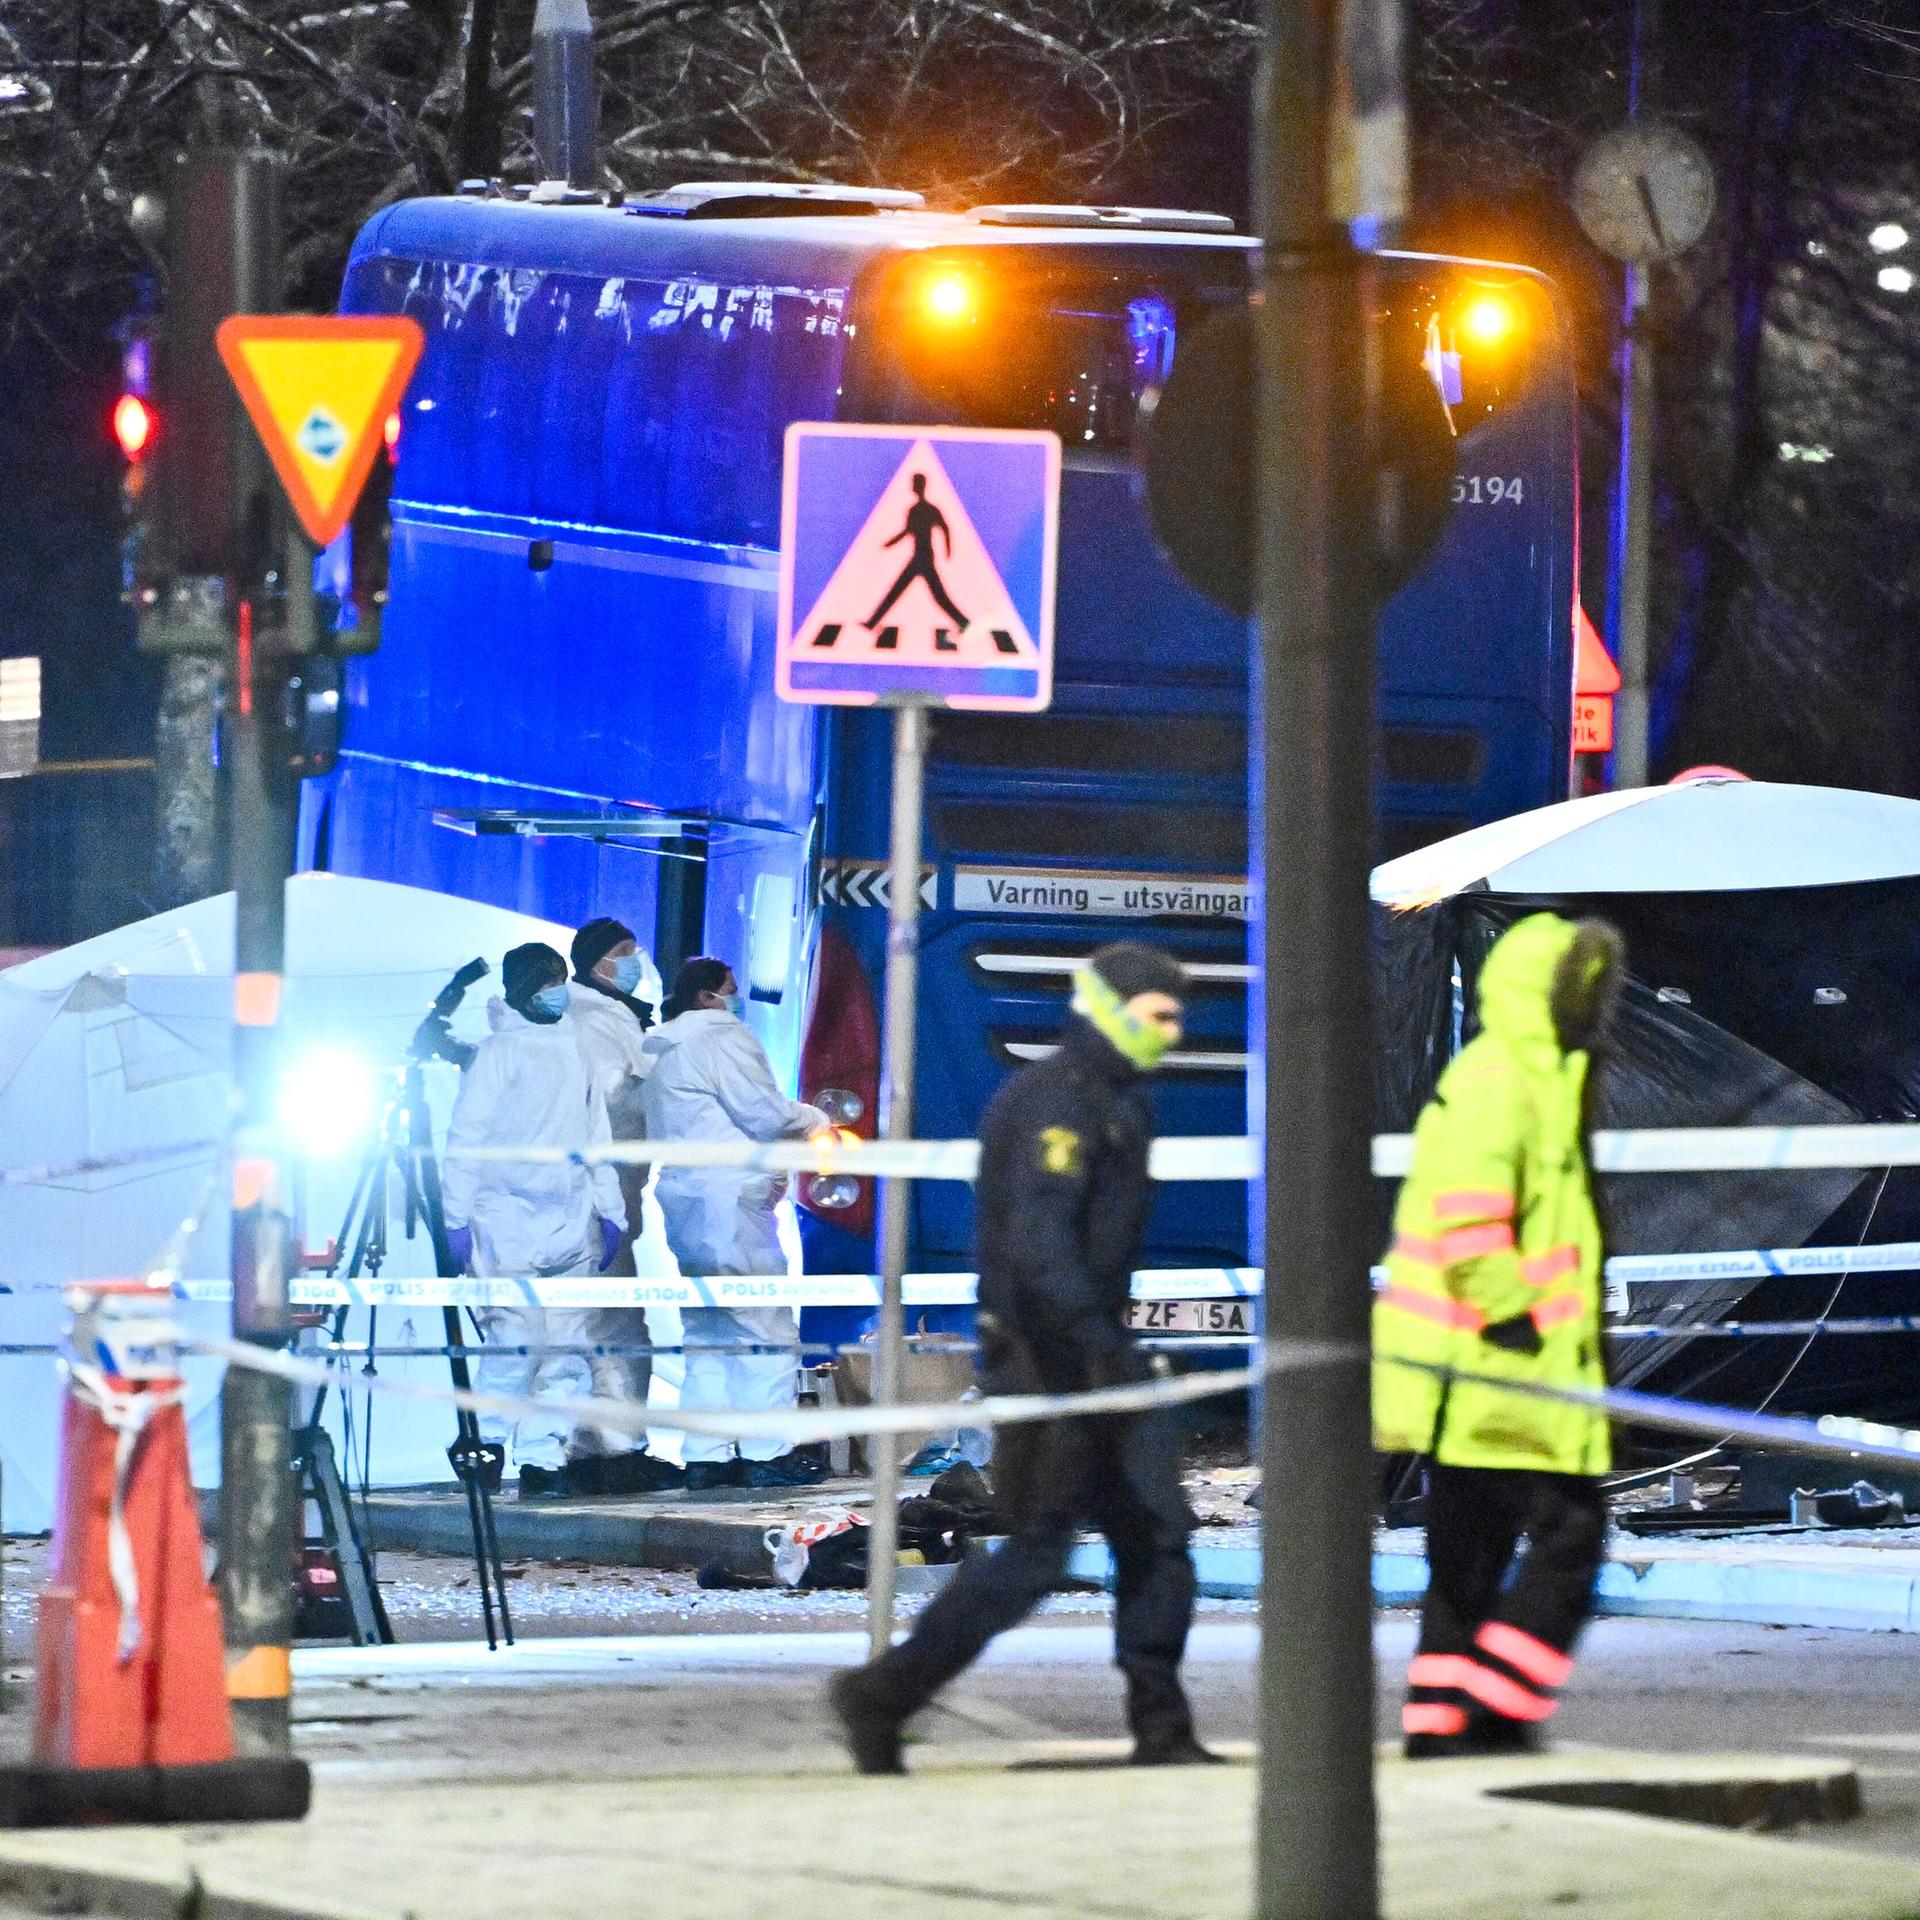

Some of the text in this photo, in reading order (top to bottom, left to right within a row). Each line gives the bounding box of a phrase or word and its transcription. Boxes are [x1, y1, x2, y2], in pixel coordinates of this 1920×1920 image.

[987, 879, 1089, 910] Varning
[370, 1283, 424, 1296] POLIS
[634, 1287, 688, 1300] POLIS
[722, 1283, 777, 1296] POLIS
[1127, 1302, 1245, 1330] FZF 15A
